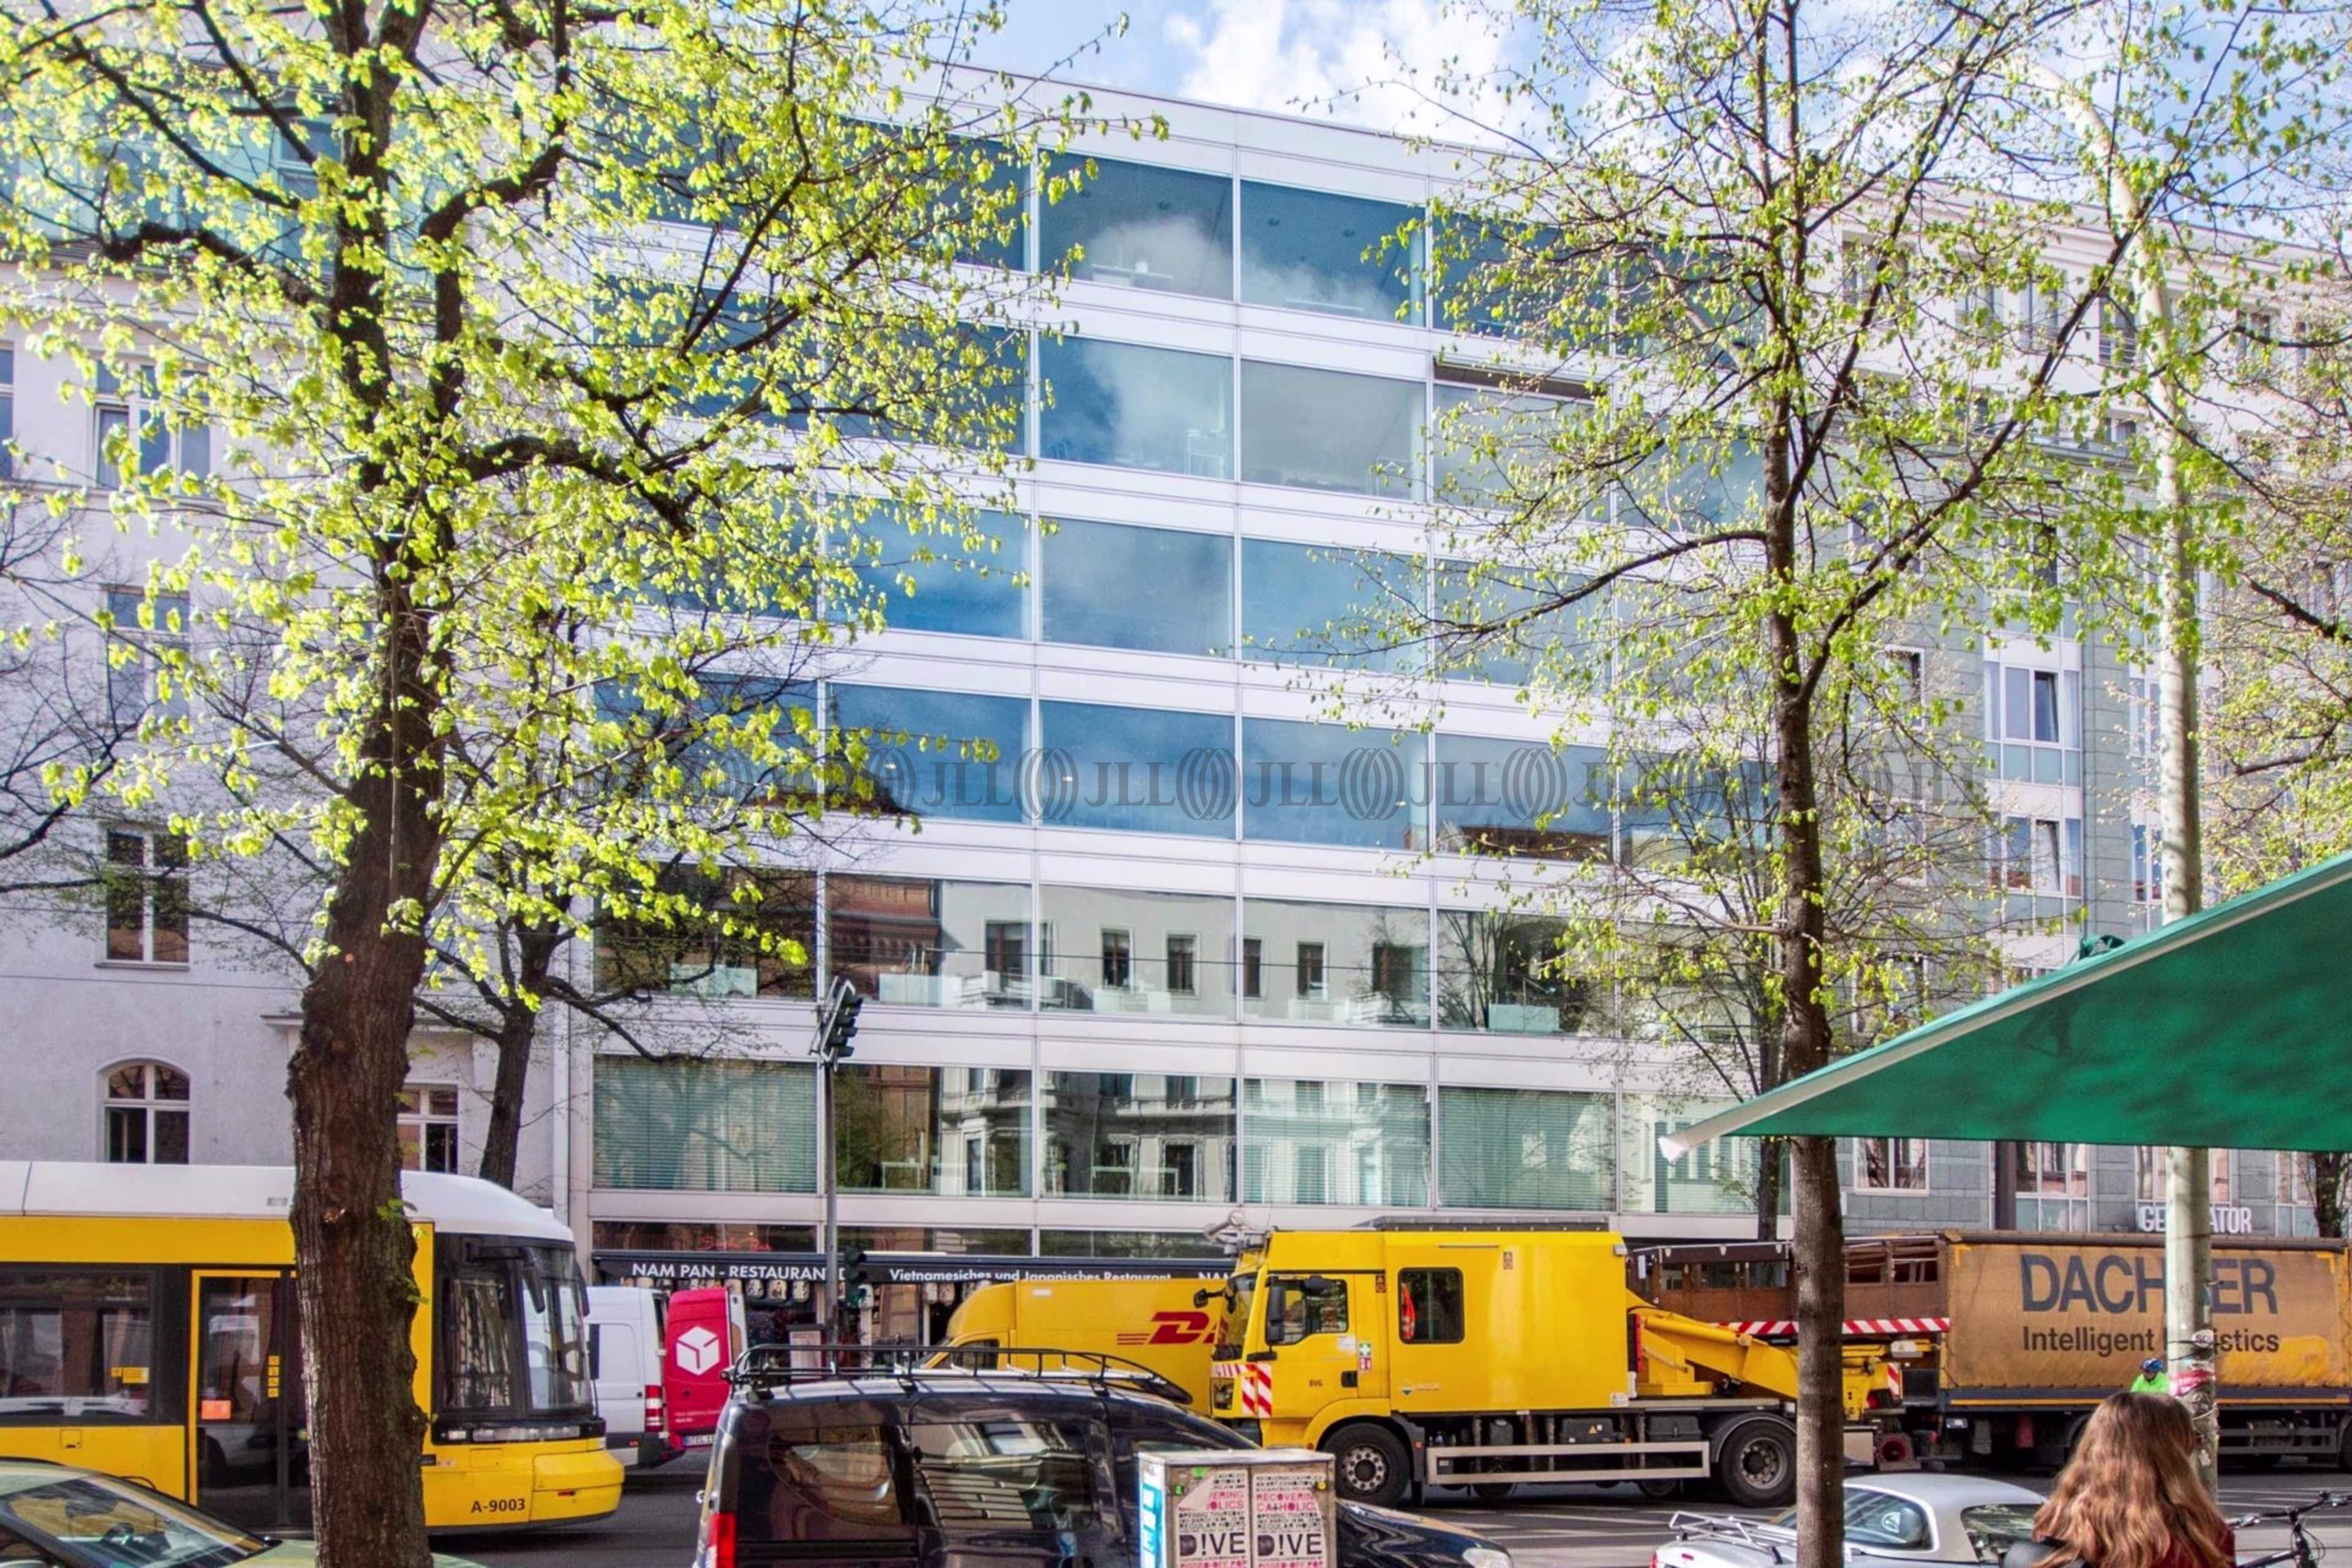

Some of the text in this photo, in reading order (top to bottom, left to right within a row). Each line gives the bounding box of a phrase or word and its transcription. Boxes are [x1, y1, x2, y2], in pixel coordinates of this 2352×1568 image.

[2140, 1206, 2252, 1234] GEATOR
[632, 1264, 674, 1278] NAM
[680, 1264, 715, 1278] PAN
[729, 1265, 826, 1281] RESTAURAN
[890, 1268, 992, 1281] Vietnamesiches
[995, 1270, 1020, 1281] und
[2021, 1254, 2278, 1314] DACHER
[2023, 1327, 2280, 1357] Intelligent istics
[470, 1499, 526, 1513] A-9003
[1257, 1502, 1317, 1512] CATHOLIC
[1179, 1532, 1246, 1557] D!VE
[1257, 1533, 1323, 1557] D!VE
